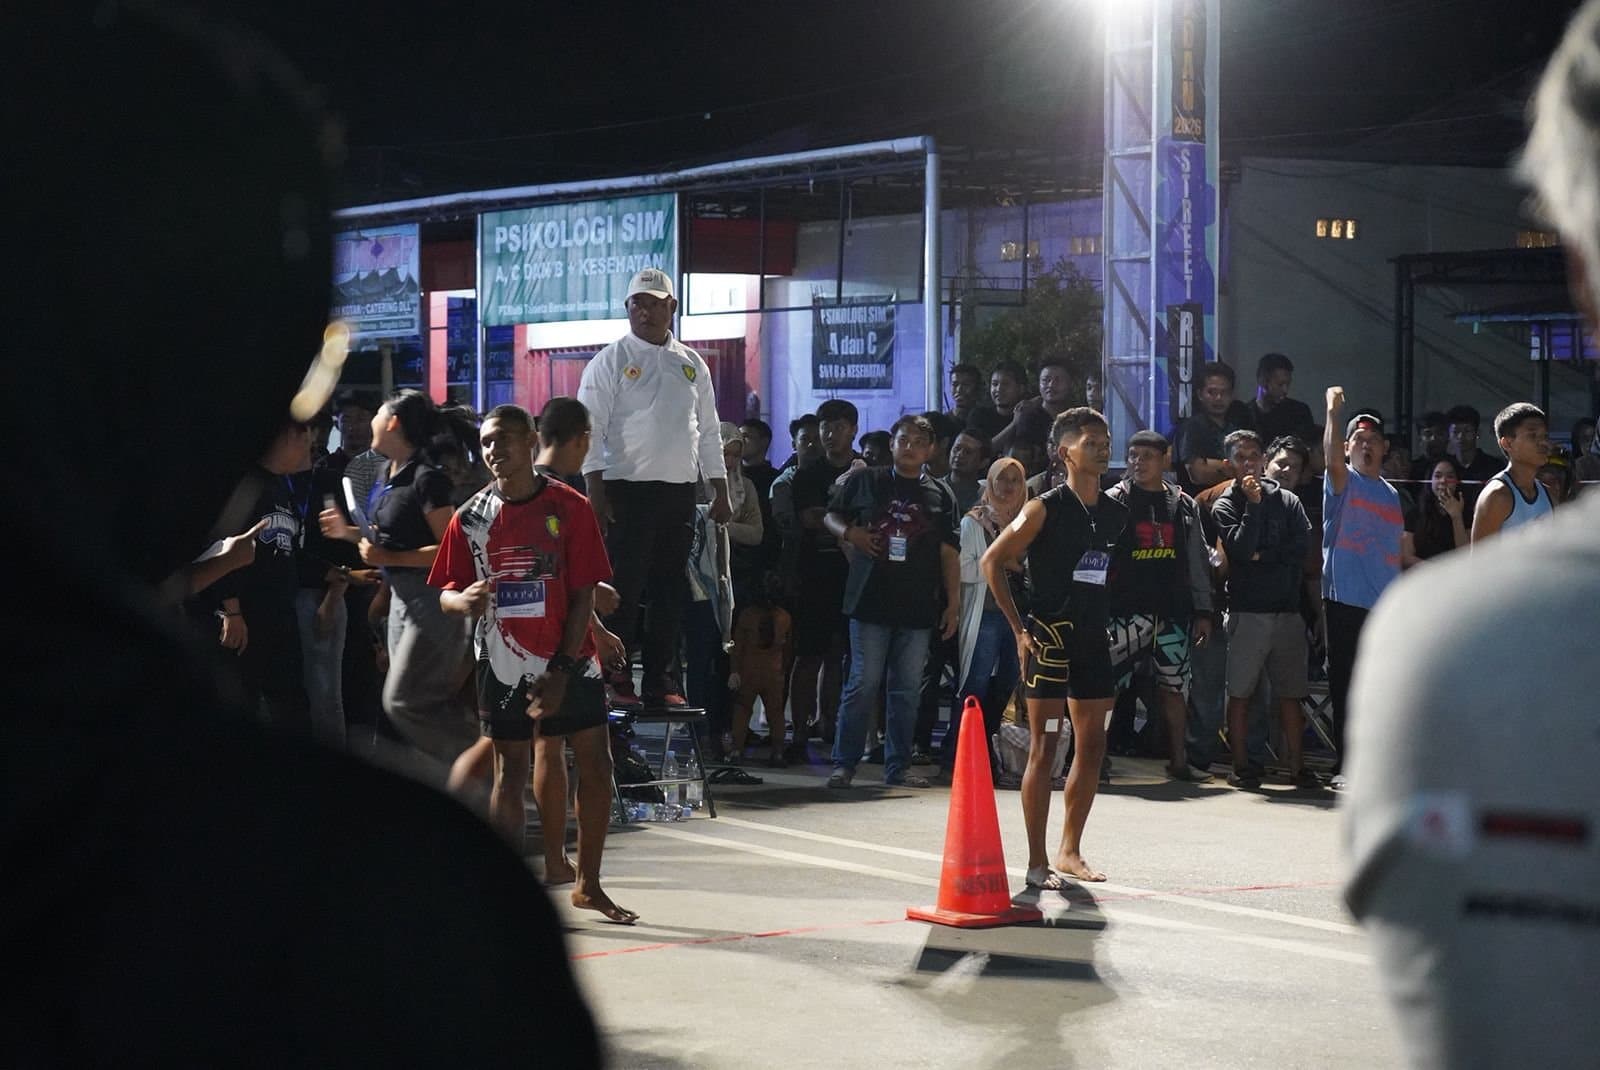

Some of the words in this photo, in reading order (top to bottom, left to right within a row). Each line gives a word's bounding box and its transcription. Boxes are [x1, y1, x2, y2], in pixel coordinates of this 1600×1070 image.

[495, 215, 613, 253] PSIKOLOGI
[621, 210, 664, 243] SIM
[1180, 147, 1194, 300] STREET
[511, 264, 520, 281] C
[523, 261, 551, 280] DAN
[553, 260, 564, 278] B
[579, 253, 664, 276] KESEHATAN
[868, 305, 887, 324] SIM
[829, 332, 839, 355] A
[841, 336, 865, 355] dan
[867, 331, 877, 355] C
[1178, 311, 1194, 419] RUN
